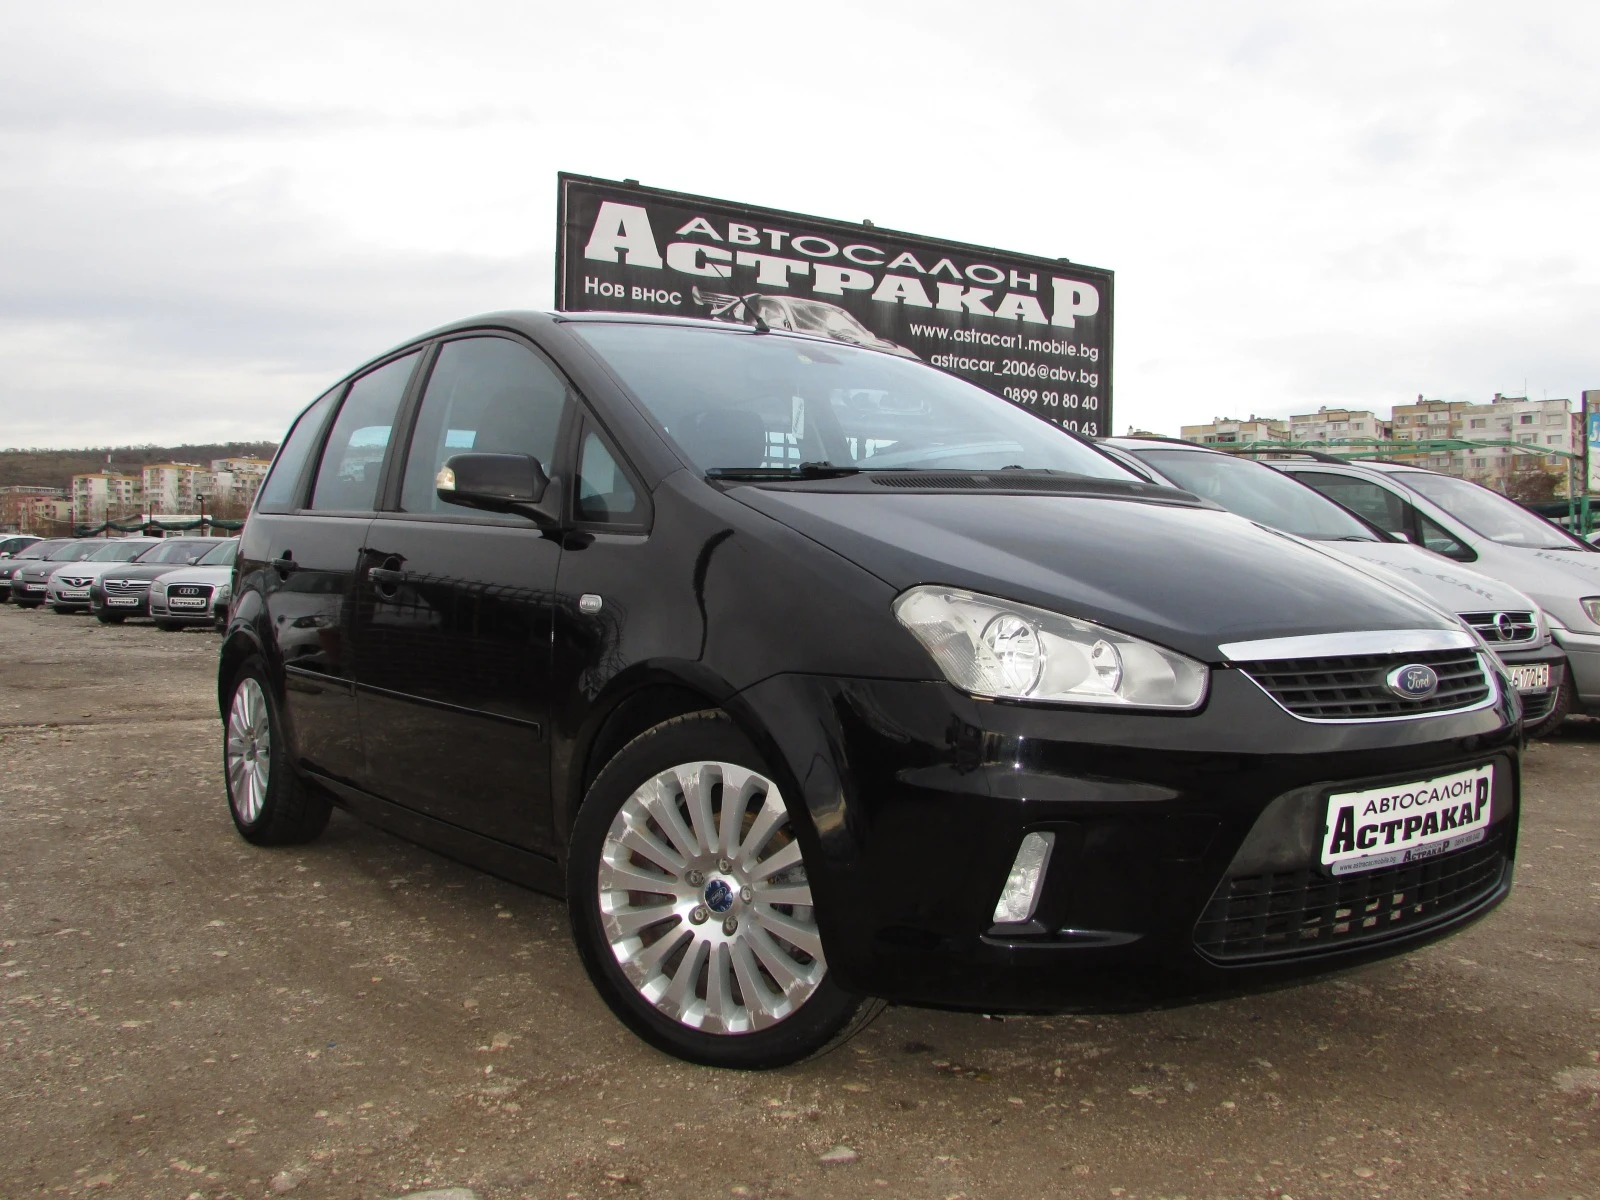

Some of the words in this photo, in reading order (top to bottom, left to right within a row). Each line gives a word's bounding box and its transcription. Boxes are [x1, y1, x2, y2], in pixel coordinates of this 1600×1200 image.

[584, 200, 1100, 329] АСТРАКАР
[676, 217, 1038, 291] АВТОСАЛОН
[909, 323, 1099, 362] www.astracar1.mobile.bg
[930, 353, 1099, 388] astracar_2006@abv.bg
[1003, 387, 1038, 405] 0899
[1042, 392, 1059, 407] 90
[1063, 394, 1079, 409] 80
[1081, 396, 1098, 411] 40
[1081, 421, 1097, 437] 43
[1407, 670, 1430, 690] Ford
[1330, 777, 1488, 854] АСТРАКАР
[1363, 779, 1472, 816] АВТОСАЛОН
